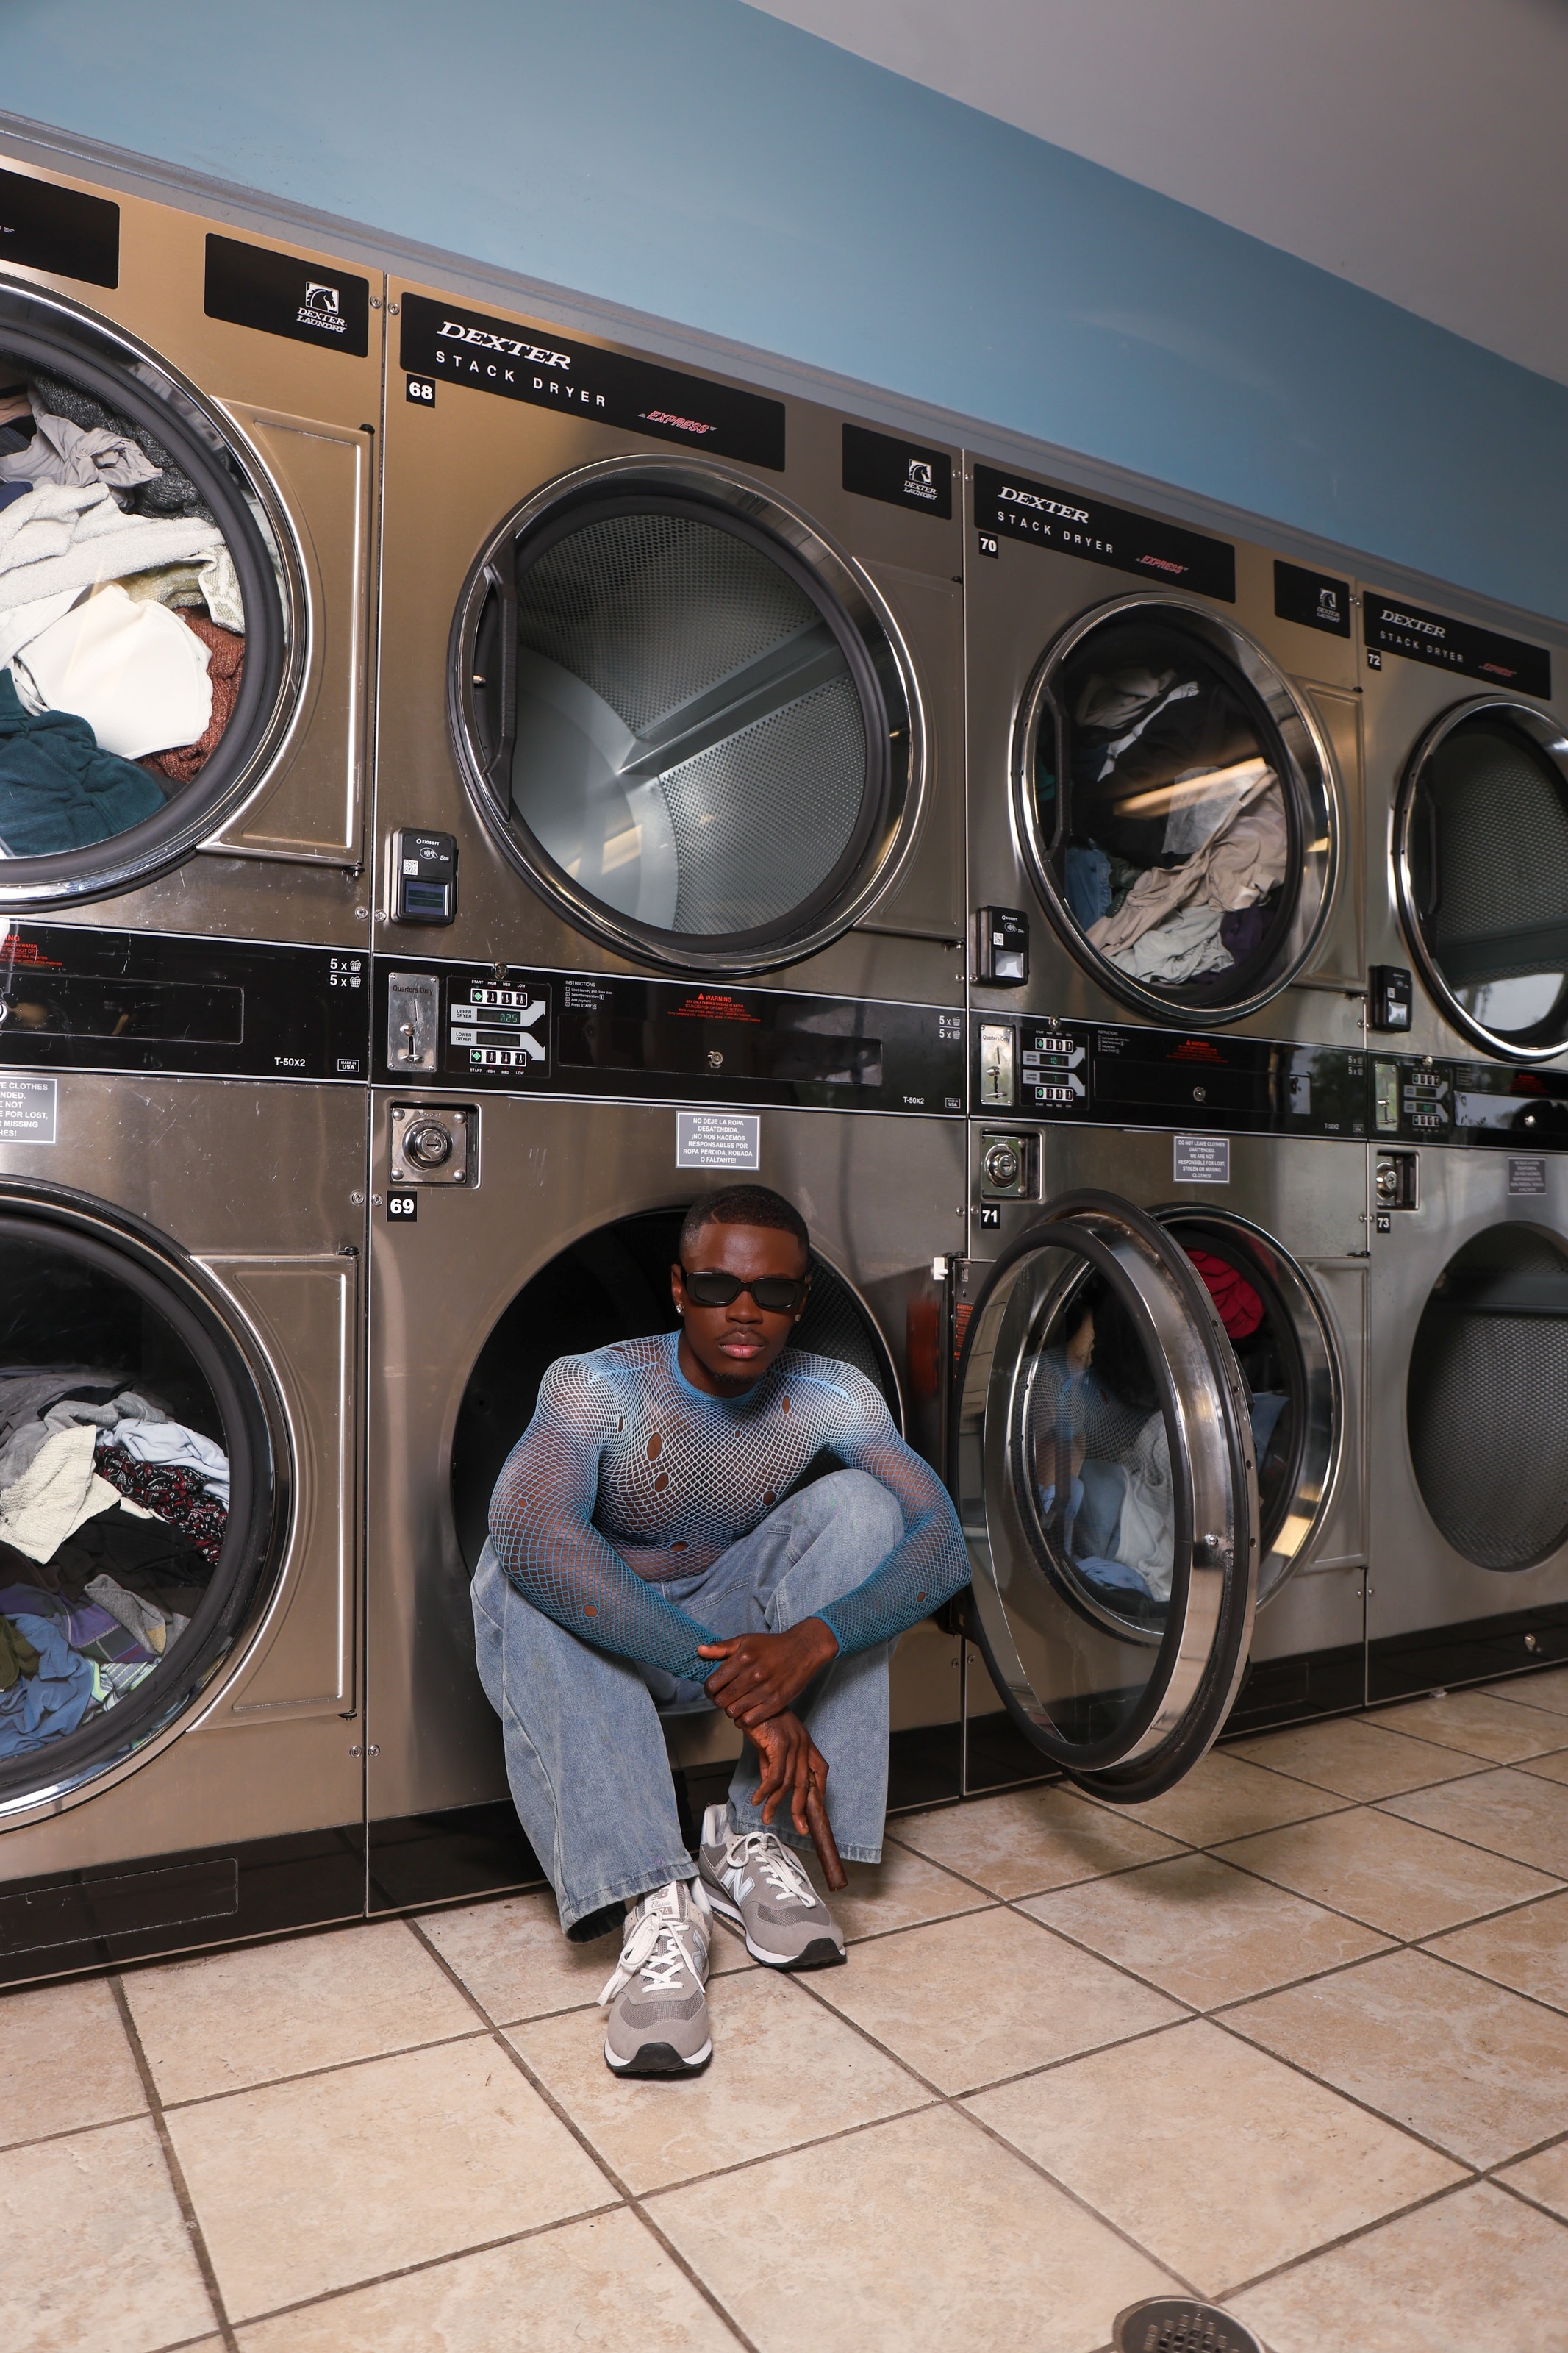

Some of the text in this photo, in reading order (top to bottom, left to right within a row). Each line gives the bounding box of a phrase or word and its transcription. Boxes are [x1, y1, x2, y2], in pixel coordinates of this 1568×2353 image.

[296, 307, 345, 326] DEXTER
[296, 315, 347, 333] LAUNDRY
[436, 321, 572, 371] DEXTER
[435, 350, 606, 407] STACK DRYER
[409, 382, 433, 400] 68
[646, 410, 709, 434] EXPRESS
[903, 480, 937, 495] DEXTER
[903, 487, 938, 501] LAUNDRY
[997, 486, 1089, 524] DEXTER
[997, 511, 1114, 554] STACK DRYER
[980, 538, 997, 552] 70
[1140, 554, 1184, 574] EXPRESS
[1380, 609, 1446, 638] DEXTER
[1380, 630, 1464, 663] STACK DRYER
[1368, 654, 1381, 666] 72
[330, 958, 338, 970] 5
[330, 974, 338, 986] 5
[393, 985, 434, 996] Quarters Only
[706, 995, 732, 1003] WARNING
[939, 1015, 945, 1025] 5
[939, 1029, 945, 1038] 5
[1000, 1035, 1010, 1043] Only
[274, 1057, 306, 1067] T-50X2
[1347, 1055, 1353, 1063] 5
[1347, 1066, 1353, 1075] 5
[9, 1082, 49, 1090] CLOTHES
[903, 1096, 924, 1104] T-50X2
[25, 1112, 48, 1120] LOST,
[4, 1120, 39, 1128] MISSING
[688, 1140, 735, 1149] RESPONSABLES
[390, 1198, 415, 1214] 69
[981, 1210, 998, 1223] 71
[1377, 1217, 1389, 1228] 73
[651, 1901, 672, 1909] Classic
